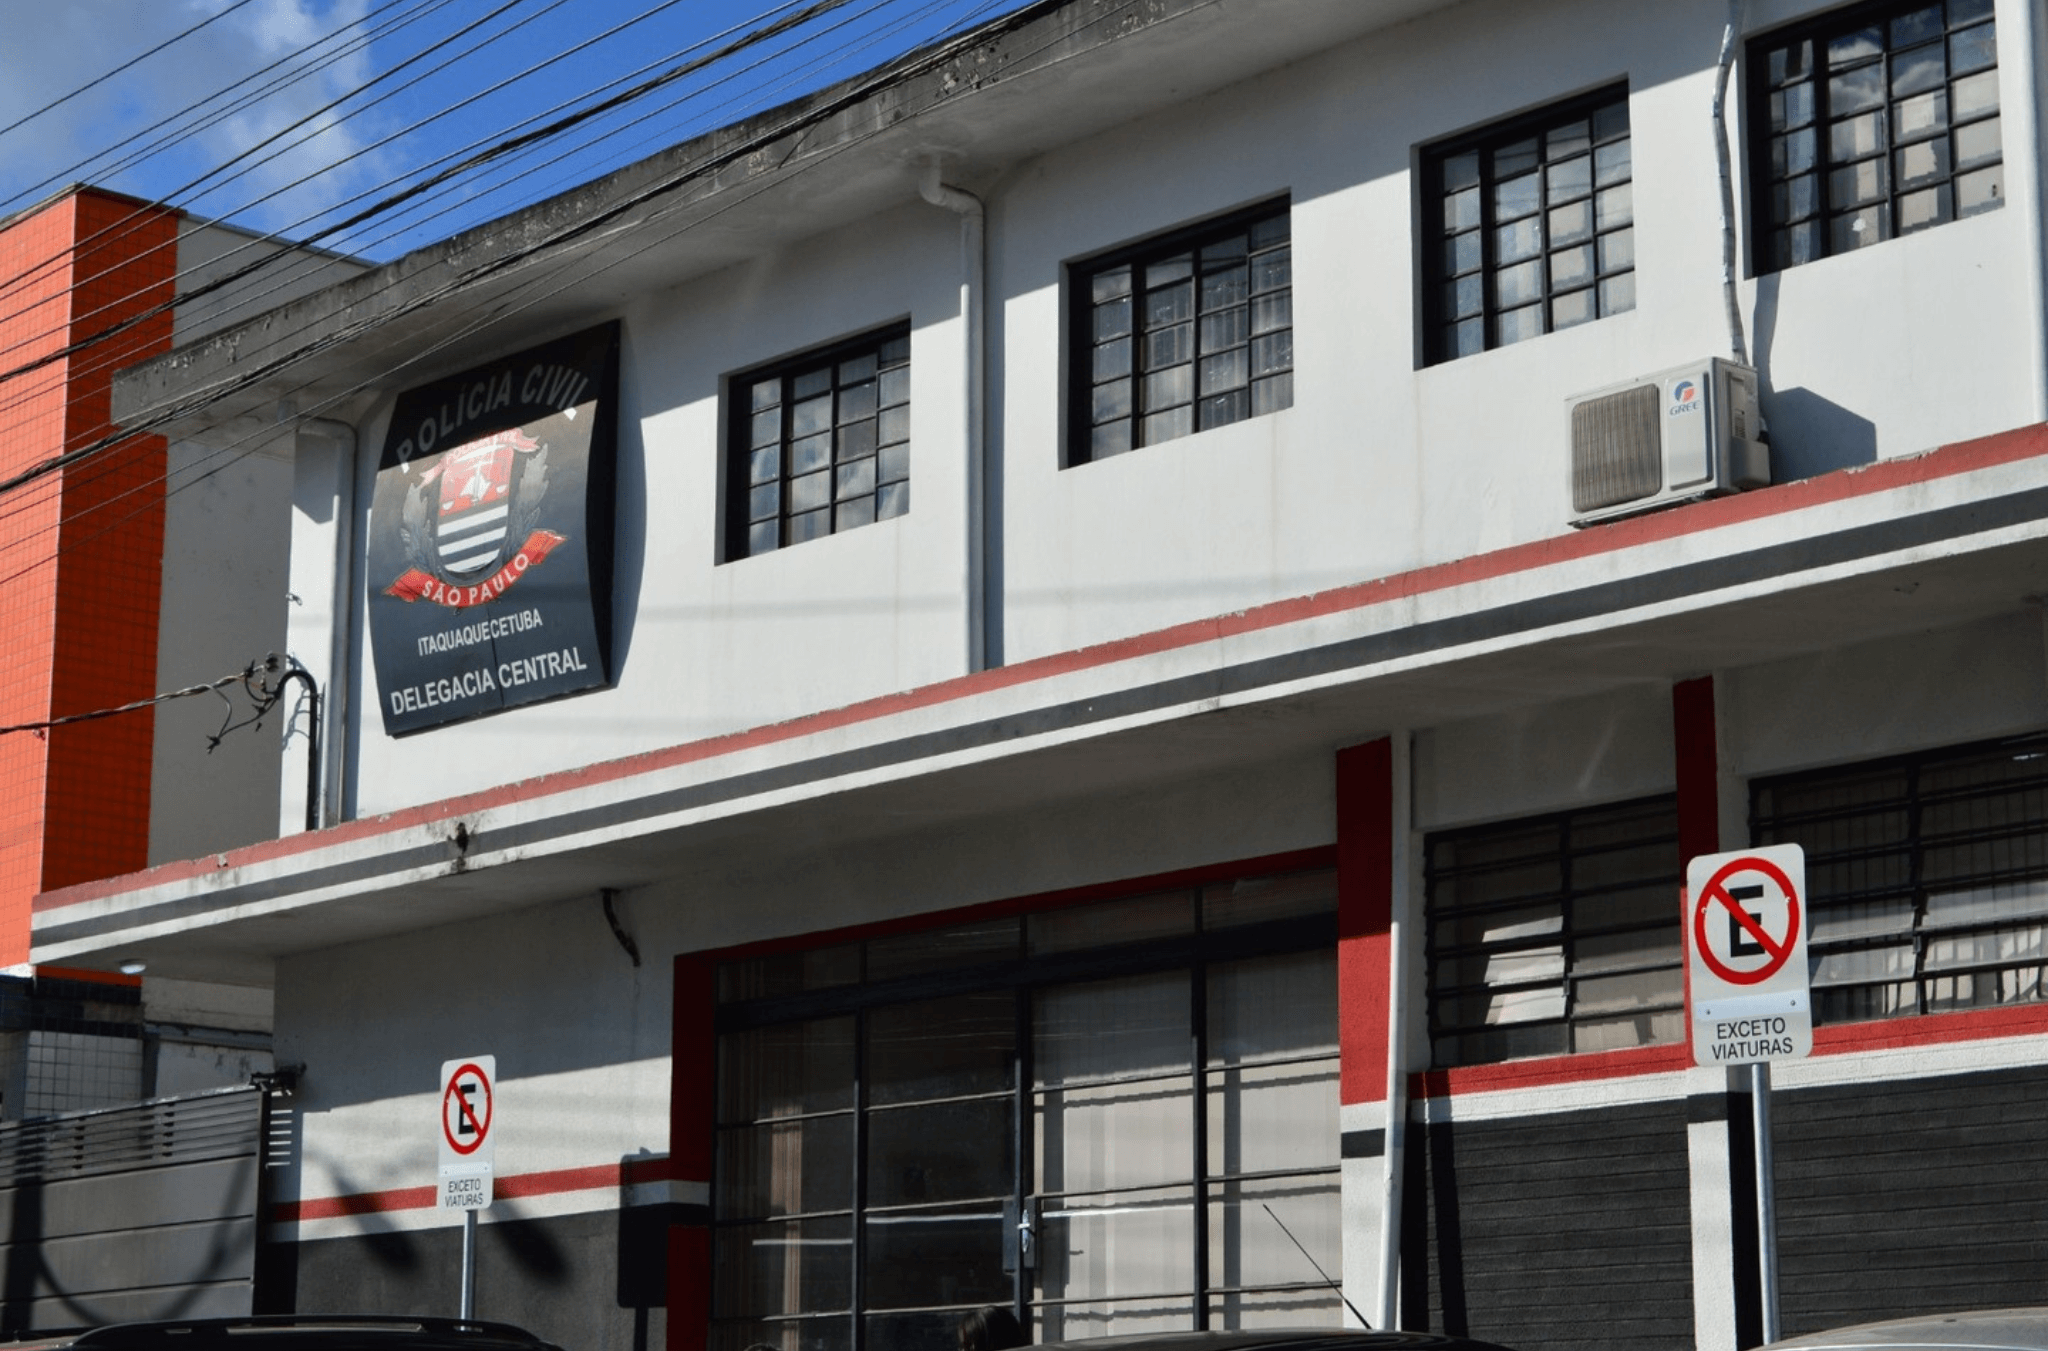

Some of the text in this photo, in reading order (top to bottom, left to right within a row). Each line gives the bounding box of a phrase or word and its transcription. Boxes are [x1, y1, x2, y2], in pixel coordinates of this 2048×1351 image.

[397, 369, 513, 474] POLÍCIA
[521, 363, 589, 421] CIVIL
[1669, 400, 1700, 416] GREE
[421, 553, 529, 606] SÃO PAULO
[417, 607, 543, 657] ITAQUAQUECETUBA
[390, 646, 588, 715] DELEGACIA CENTRAL
[1728, 884, 1766, 958] E
[1716, 1016, 1786, 1040] EXCETO
[1711, 1037, 1794, 1061] VIATURAS
[444, 1192, 484, 1209] VIATURAS
[447, 1177, 482, 1194] EXCETO
